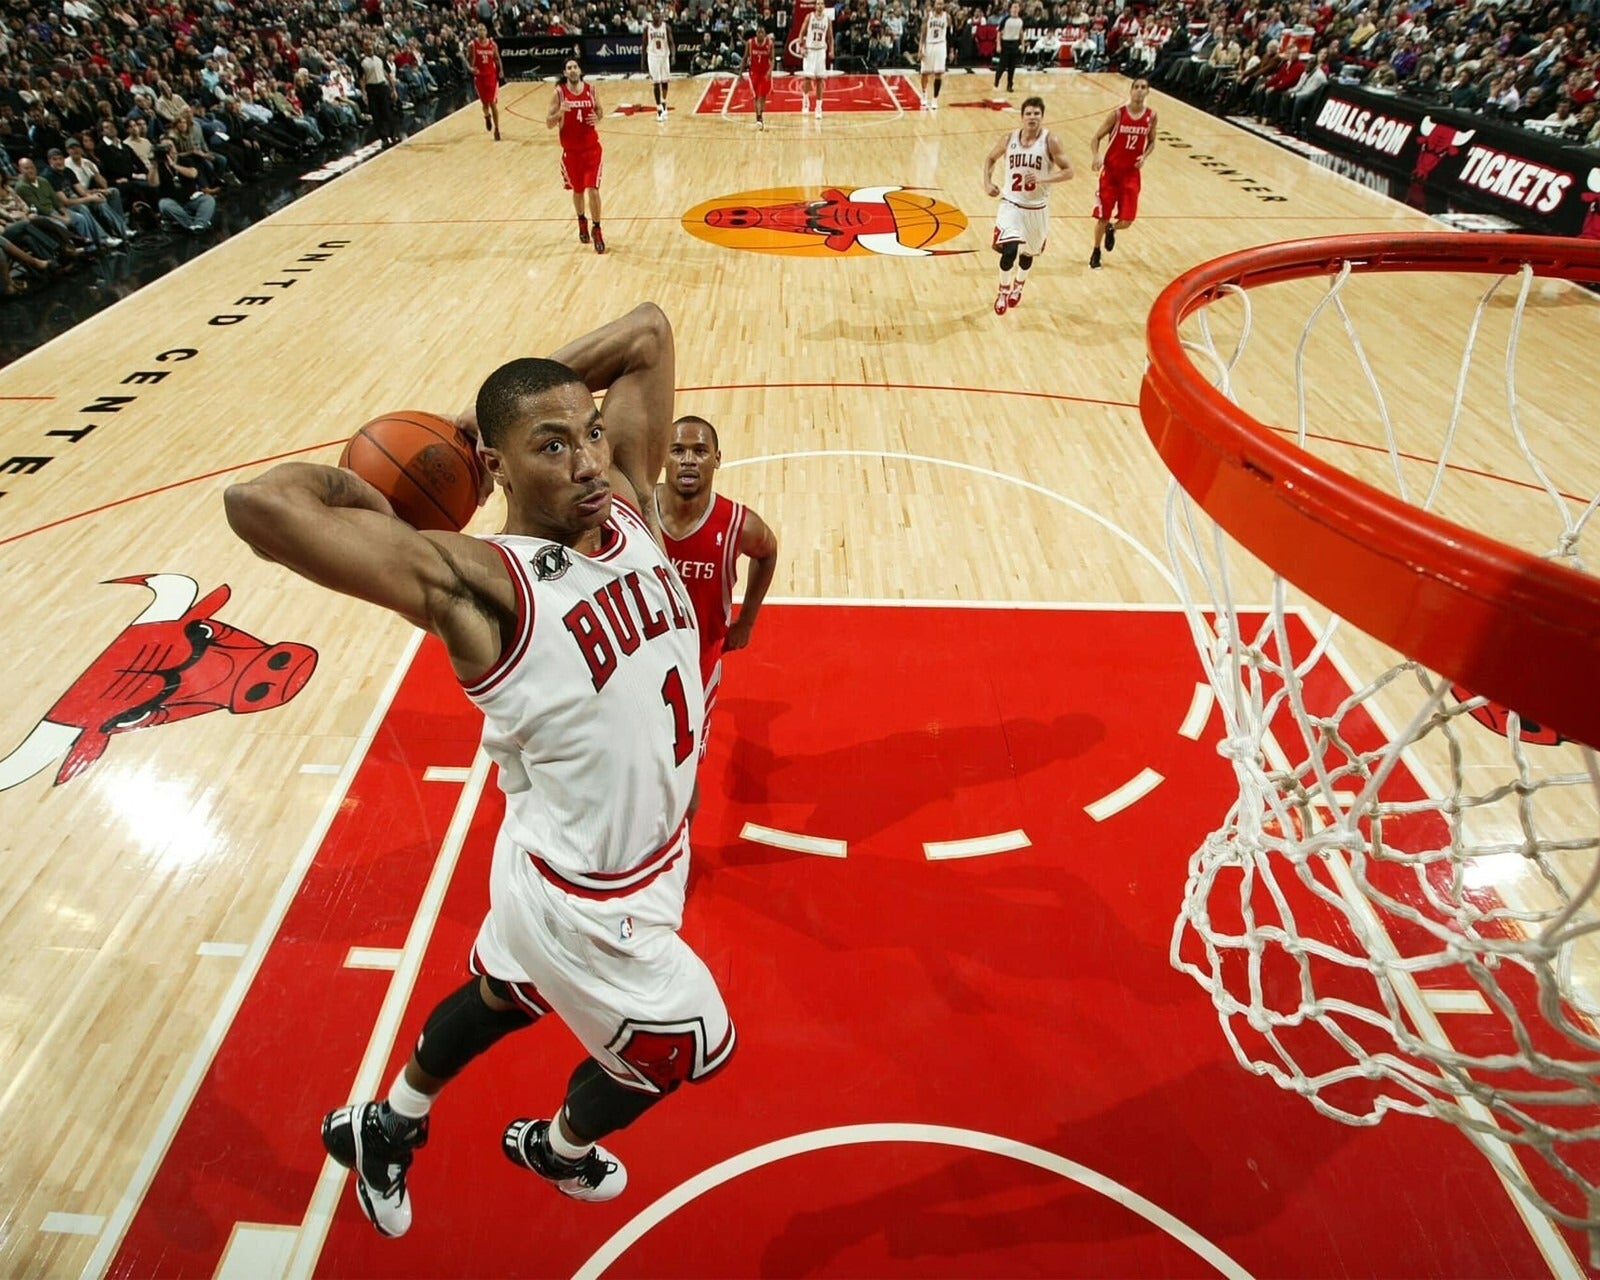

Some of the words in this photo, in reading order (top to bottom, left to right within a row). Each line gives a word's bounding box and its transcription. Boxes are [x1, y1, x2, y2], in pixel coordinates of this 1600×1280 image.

[501, 48, 529, 57] BUD
[534, 47, 572, 56] LIGHT
[813, 32, 823, 42] 13
[576, 109, 583, 123] 4
[1316, 99, 1413, 156] BULLS.COM
[1009, 154, 1042, 171] BULLS
[1125, 134, 1139, 150] 12
[1189, 155, 1288, 202] CENTER
[1459, 146, 1572, 213] TICKETS
[208, 240, 352, 326] UNITED
[0, 348, 199, 499] CENTE
[671, 557, 715, 580] KETS
[562, 565, 695, 694] BULL
[661, 665, 694, 768] 1
